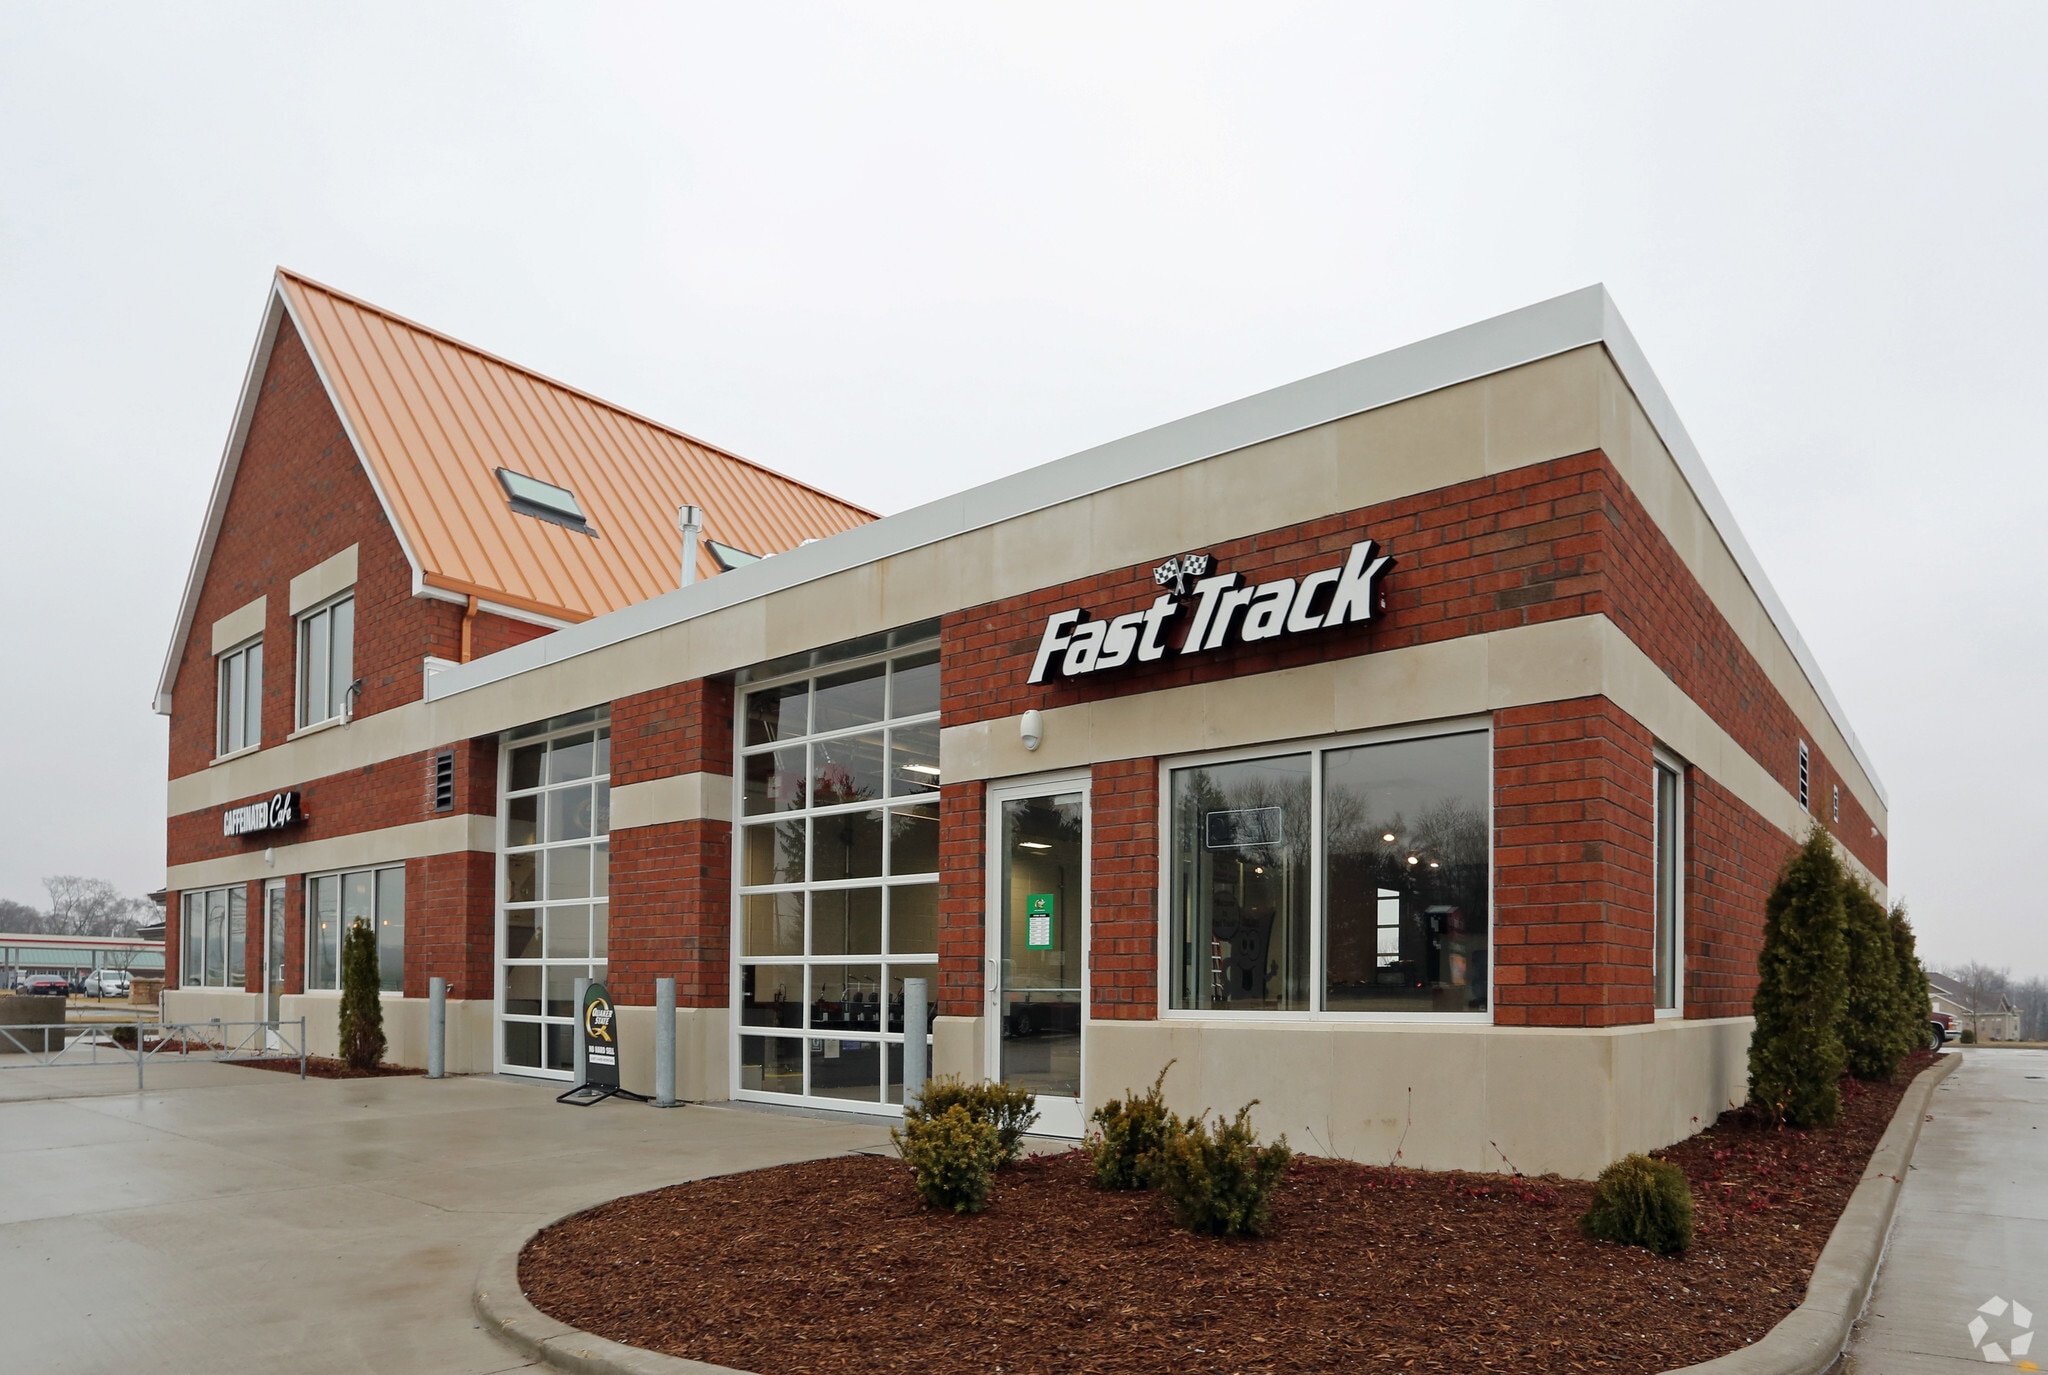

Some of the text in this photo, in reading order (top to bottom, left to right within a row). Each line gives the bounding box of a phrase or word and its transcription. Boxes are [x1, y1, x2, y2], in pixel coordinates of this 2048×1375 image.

[1026, 539, 1393, 685] Fast Track
[224, 792, 292, 836] CAFFEINATED Cafe
[592, 1007, 613, 1018] QUAKER
[594, 1017, 610, 1025] STATE
